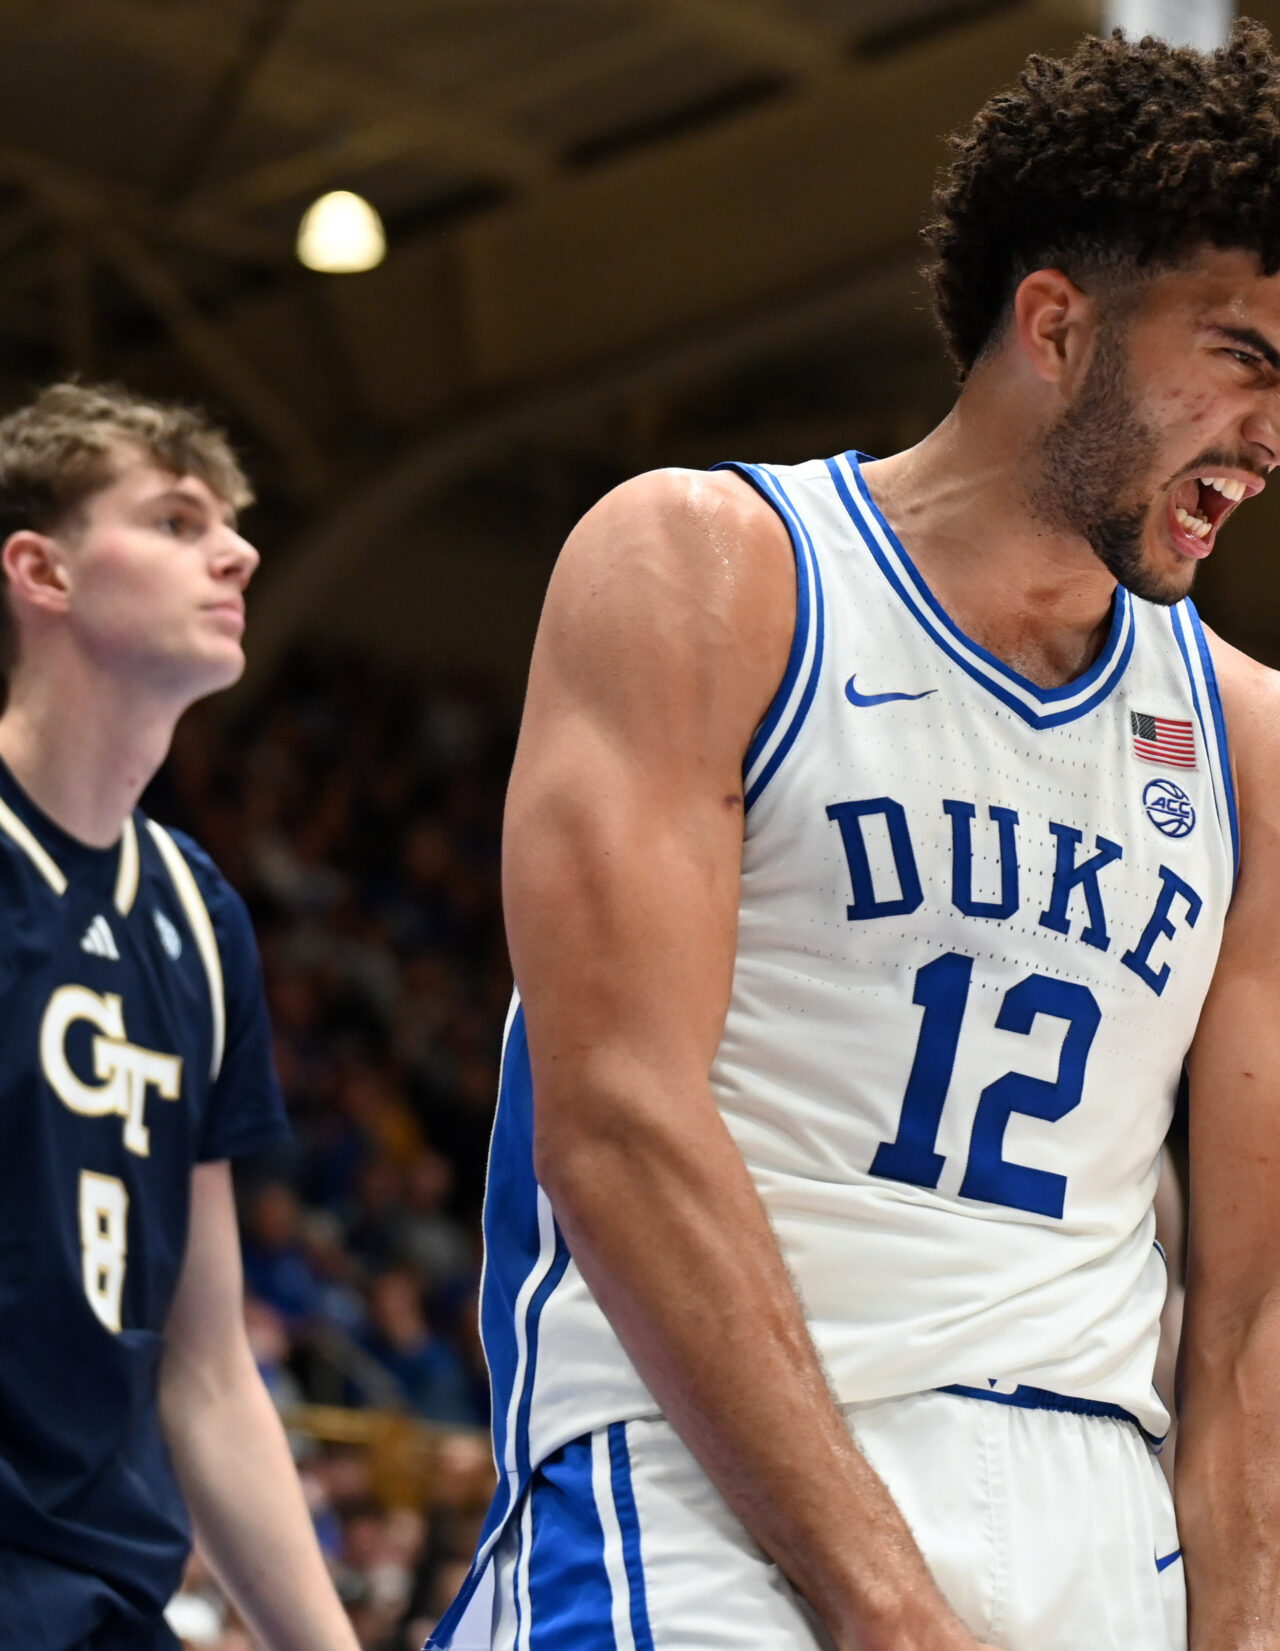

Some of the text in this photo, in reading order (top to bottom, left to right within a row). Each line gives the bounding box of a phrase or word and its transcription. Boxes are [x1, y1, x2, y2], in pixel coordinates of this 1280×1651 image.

[1150, 796, 1192, 816] ACC
[825, 796, 1203, 997] DUKE
[39, 983, 184, 1159] GT
[868, 951, 1102, 1220] 12
[78, 1168, 130, 1334] 8
